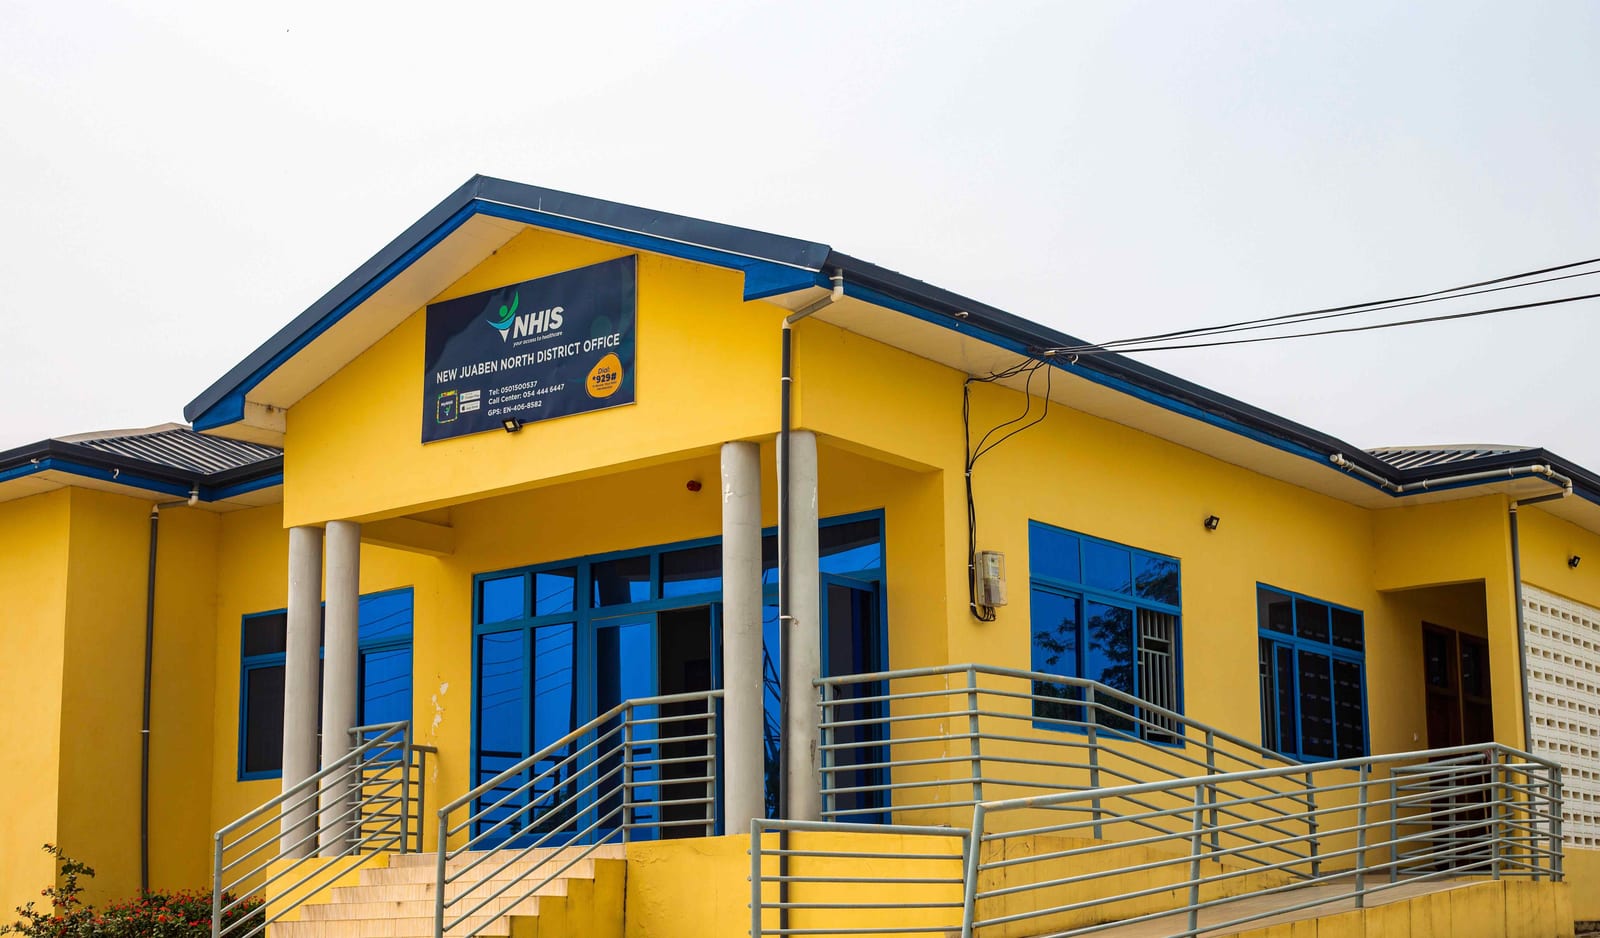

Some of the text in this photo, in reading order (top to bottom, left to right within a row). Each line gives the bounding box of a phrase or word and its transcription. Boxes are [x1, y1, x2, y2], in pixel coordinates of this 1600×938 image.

[513, 306, 564, 339] NHIS
[542, 331, 563, 340] healthcare
[436, 333, 620, 384] NEW JUABEN NORTH DISTRICT OFFICE
[488, 383, 565, 405] Call Center: 054 444 6447
[489, 388, 500, 396] Tel:
[500, 381, 538, 393] 0501500537
[487, 400, 542, 416] GPS: EN-406-8582
